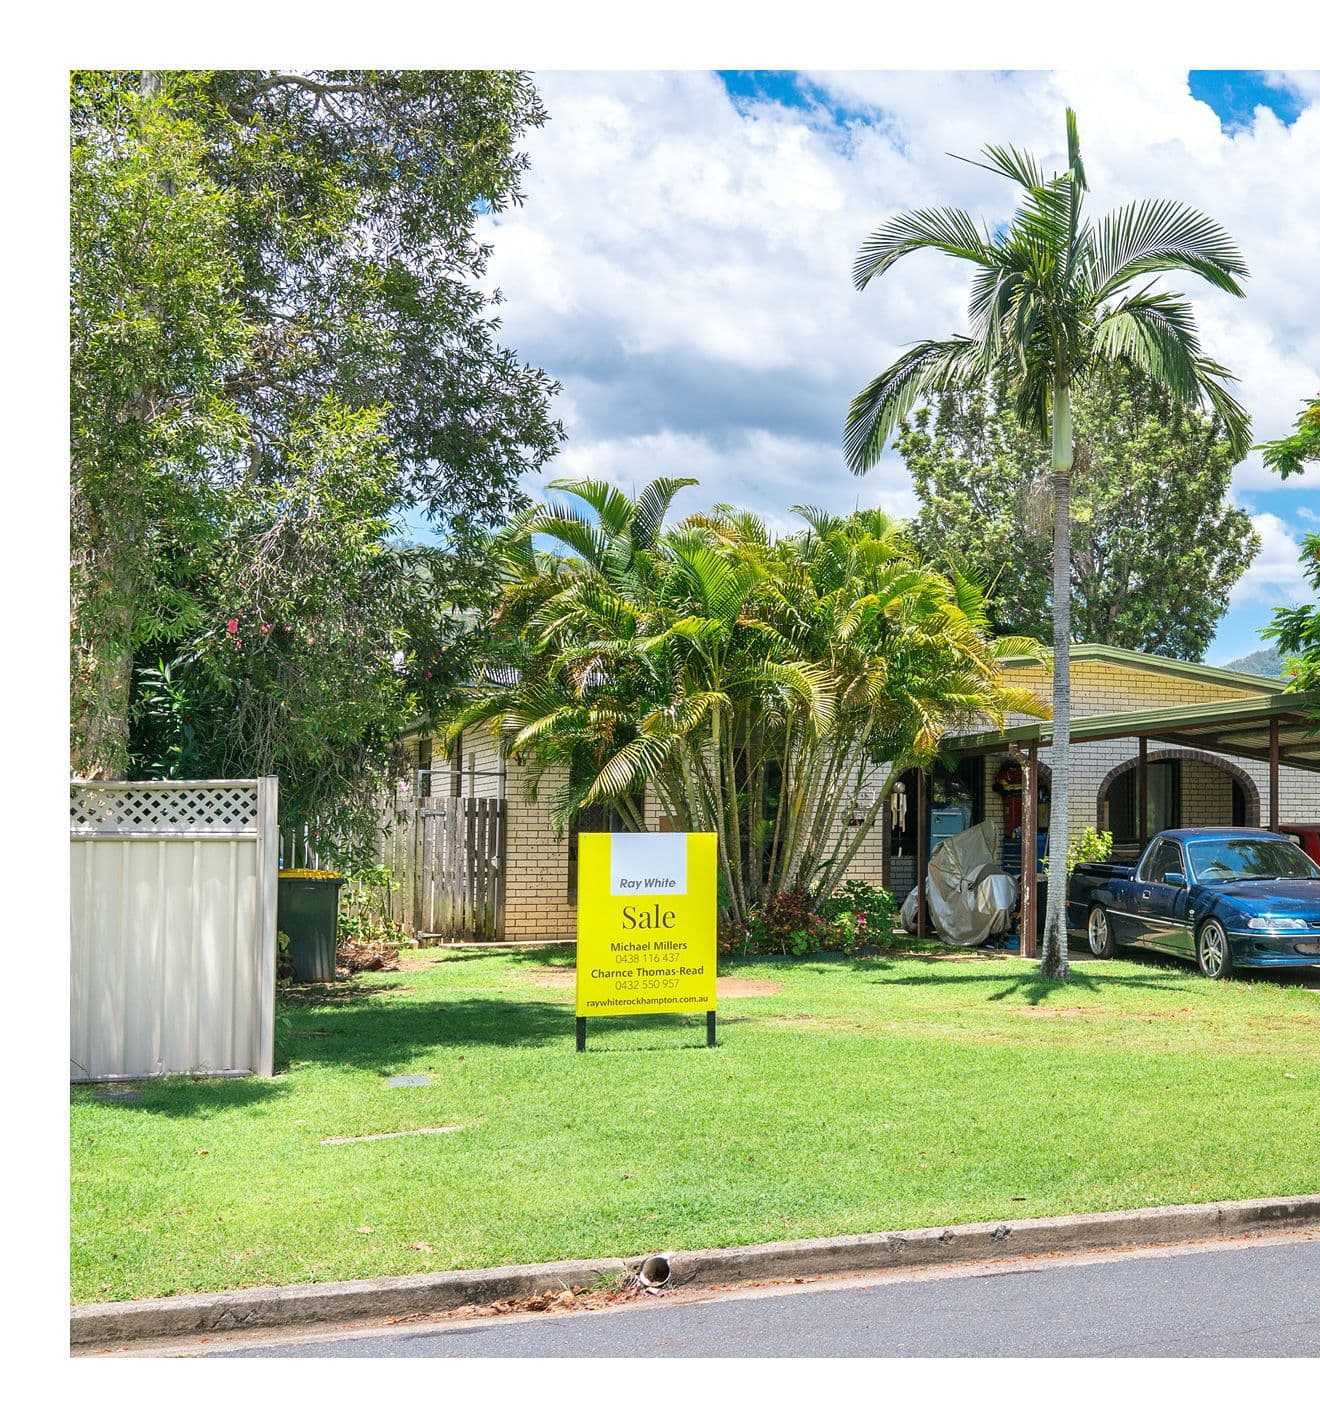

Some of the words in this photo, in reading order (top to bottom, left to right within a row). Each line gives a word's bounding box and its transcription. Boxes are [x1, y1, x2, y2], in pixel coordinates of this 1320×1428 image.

[619, 878, 642, 890] Ray
[644, 877, 676, 889] White
[622, 903, 676, 930] Sale
[610, 942, 651, 952] Michael
[653, 941, 688, 951] Millers
[615, 954, 640, 964] 0438
[643, 953, 660, 963] 116
[662, 952, 680, 963] 437
[591, 968, 633, 979] Charnce
[636, 965, 704, 977] Thomas-Read
[615, 980, 640, 991] 0432
[642, 979, 660, 990] 550
[662, 978, 680, 989] 957
[586, 995, 709, 1009] raywhiterockhampton.com.au
